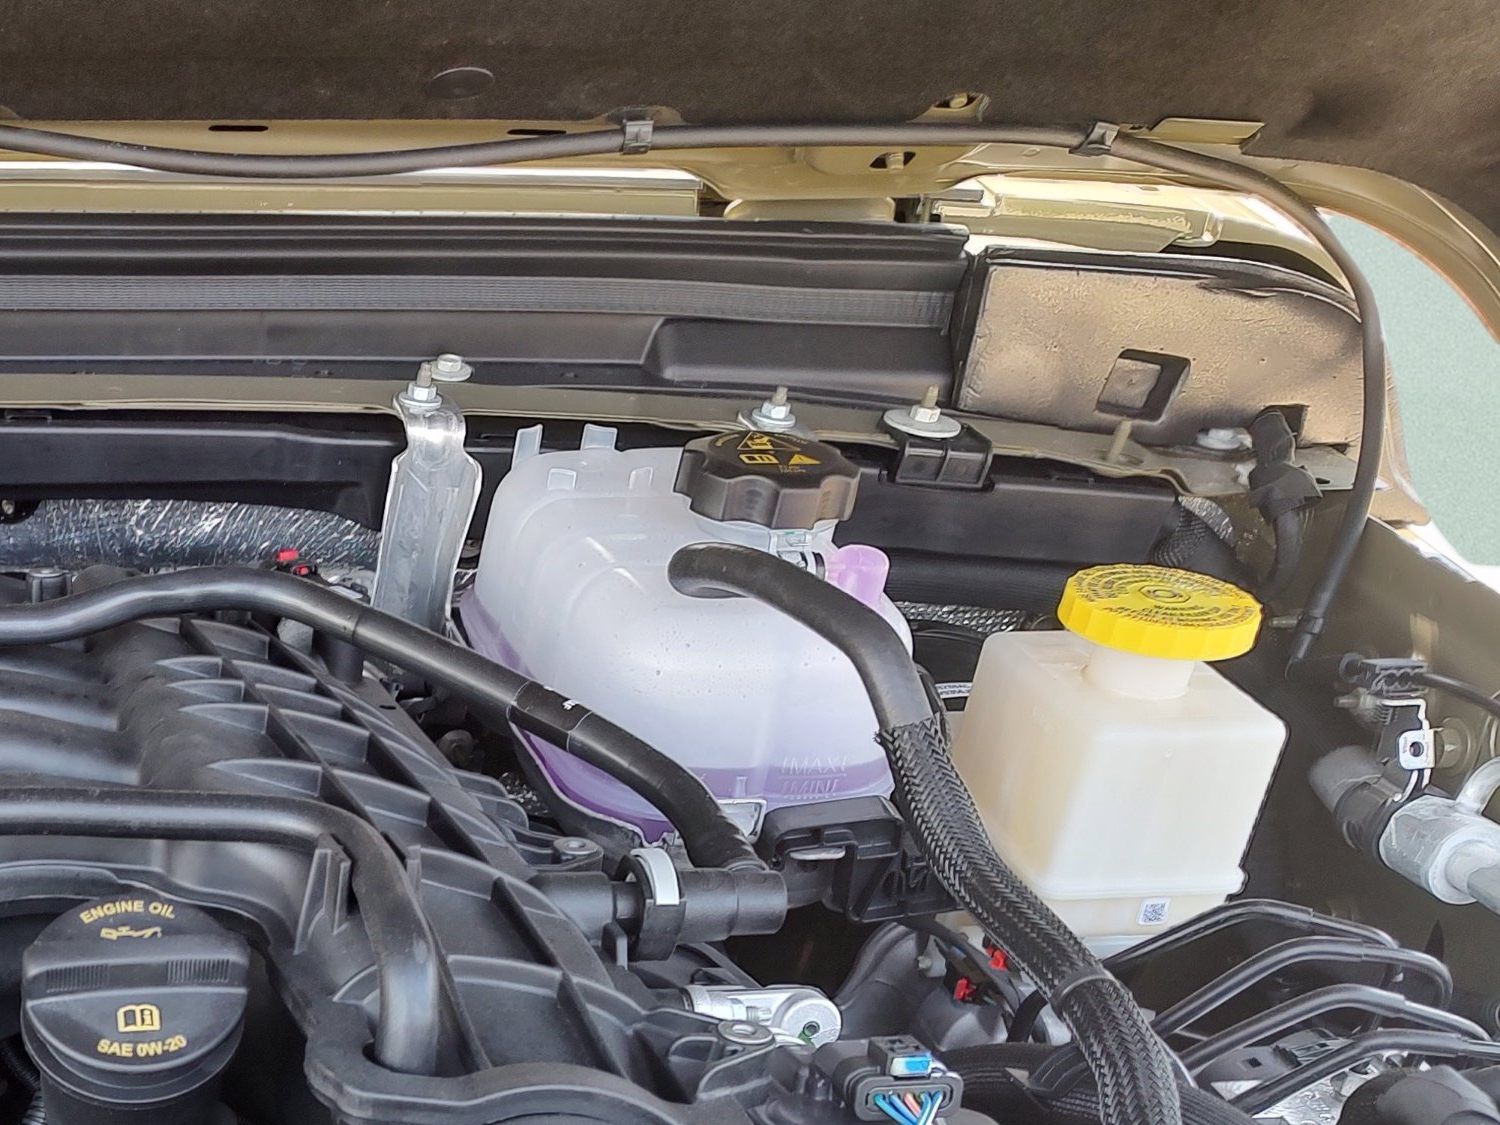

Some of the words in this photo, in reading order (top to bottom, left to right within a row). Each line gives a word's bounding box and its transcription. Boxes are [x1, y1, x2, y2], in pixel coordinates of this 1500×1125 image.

[79, 900, 145, 924] ENGINE
[148, 903, 176, 919] OIL
[97, 1038, 134, 1057] SAE
[136, 1034, 187, 1057] 0W-20
